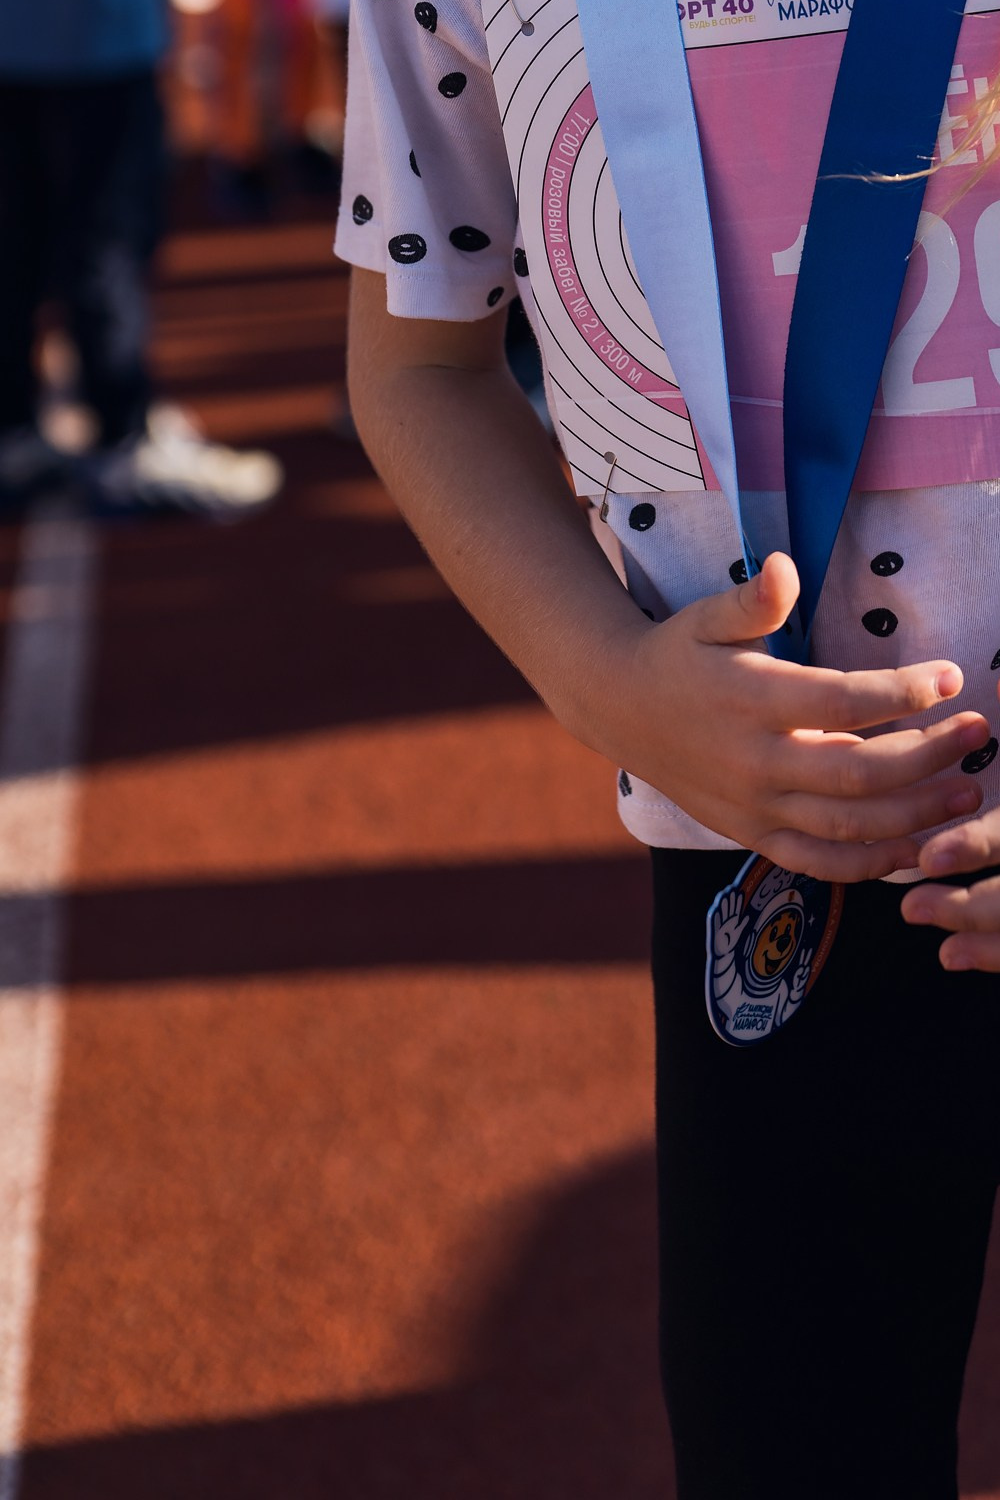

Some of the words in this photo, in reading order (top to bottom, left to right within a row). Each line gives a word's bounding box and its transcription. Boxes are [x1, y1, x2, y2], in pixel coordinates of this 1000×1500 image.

[689, 20, 711, 29] БУДЬ
[711, 19, 718, 27] В
[719, 15, 756, 26] СПОРТЕ!
[559, 111, 591, 157] 17:00
[548, 165, 567, 243] розовый
[553, 248, 578, 294] забег
[570, 296, 590, 319] №
[582, 318, 599, 333] 2
[600, 339, 629, 370] 300
